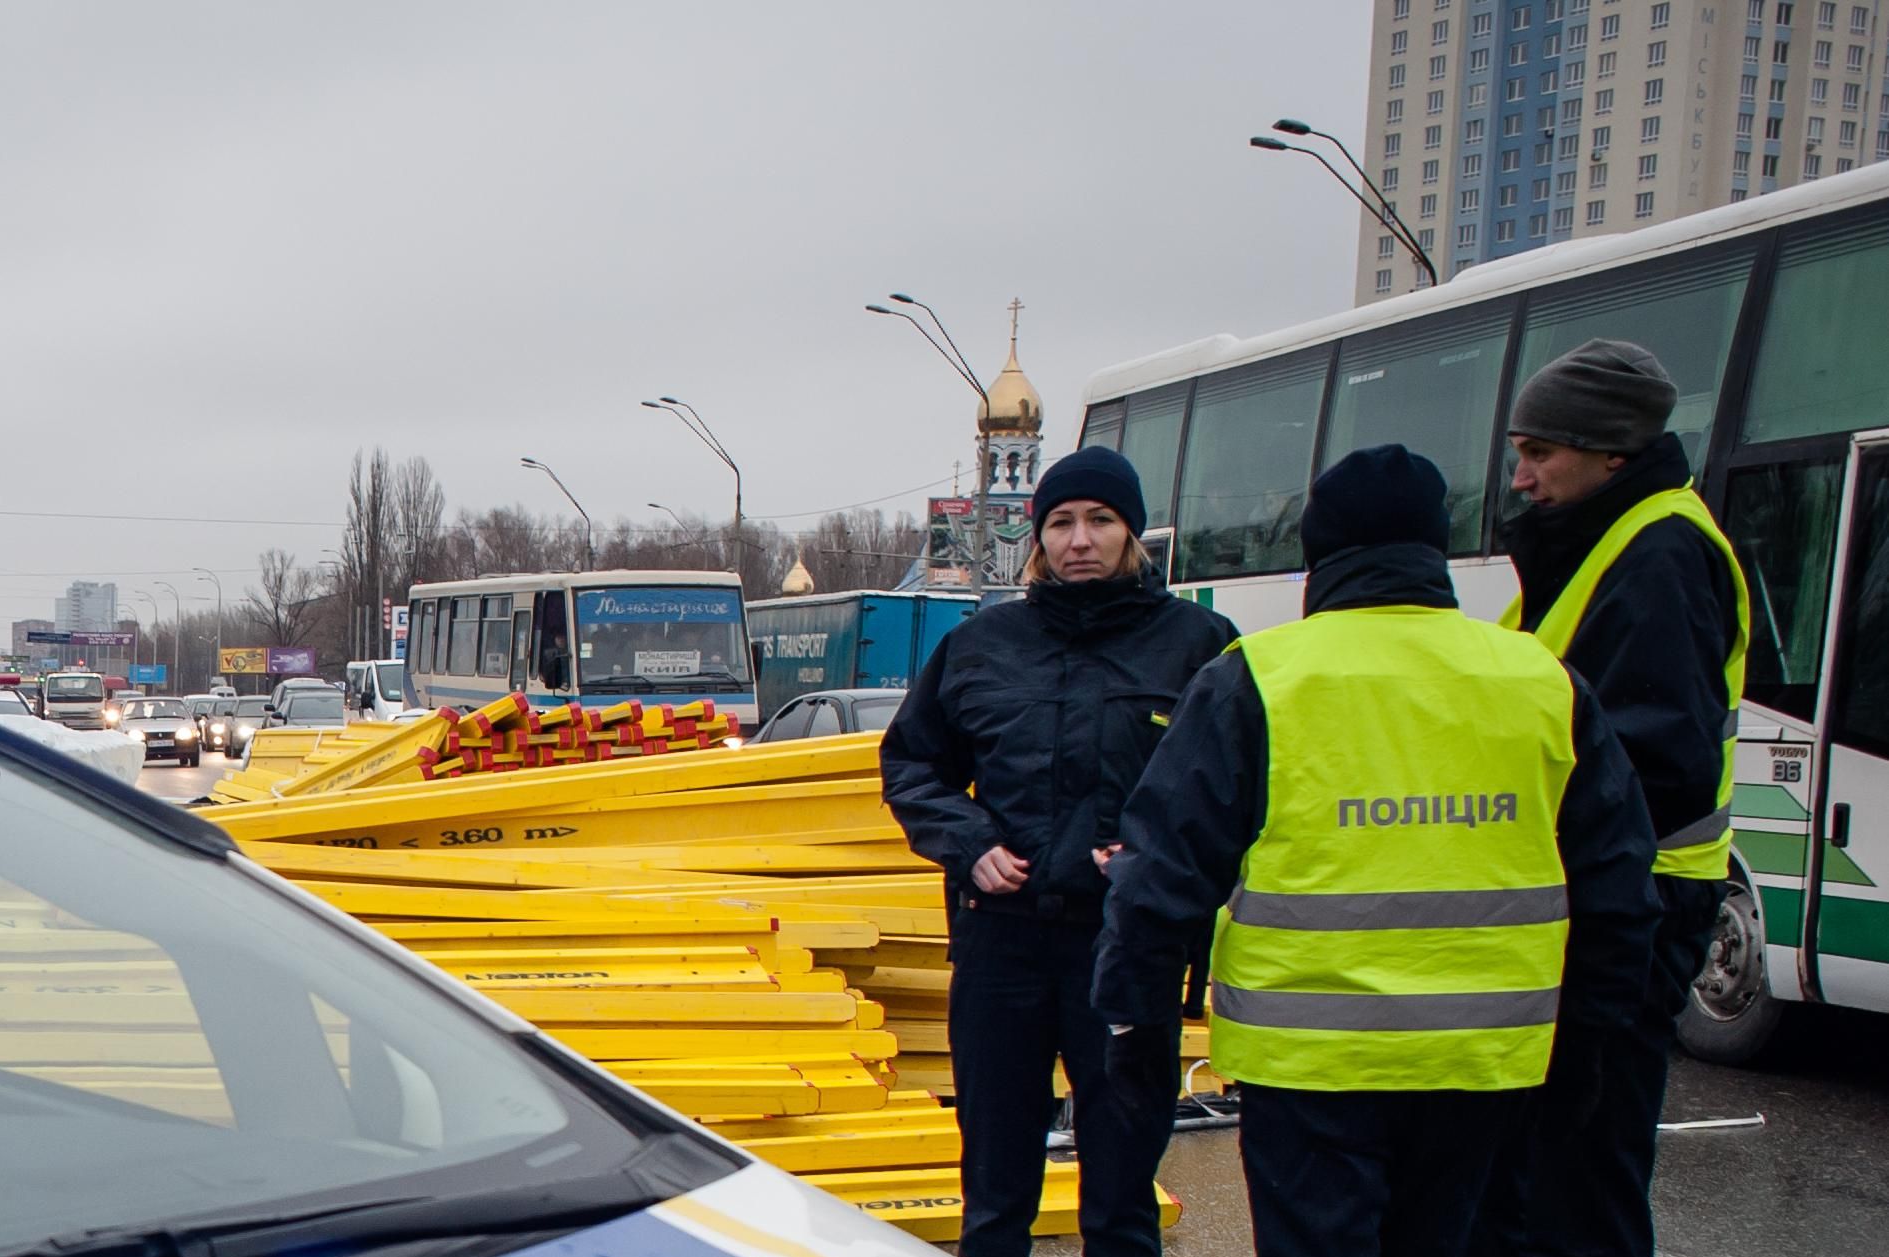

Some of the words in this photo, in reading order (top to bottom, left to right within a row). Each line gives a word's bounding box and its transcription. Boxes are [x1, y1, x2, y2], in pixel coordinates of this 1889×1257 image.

[776, 633, 828, 659] TRANSPORT
[1339, 792, 1518, 829] ПОЛІЦІЯ
[439, 826, 504, 847] 3.60
